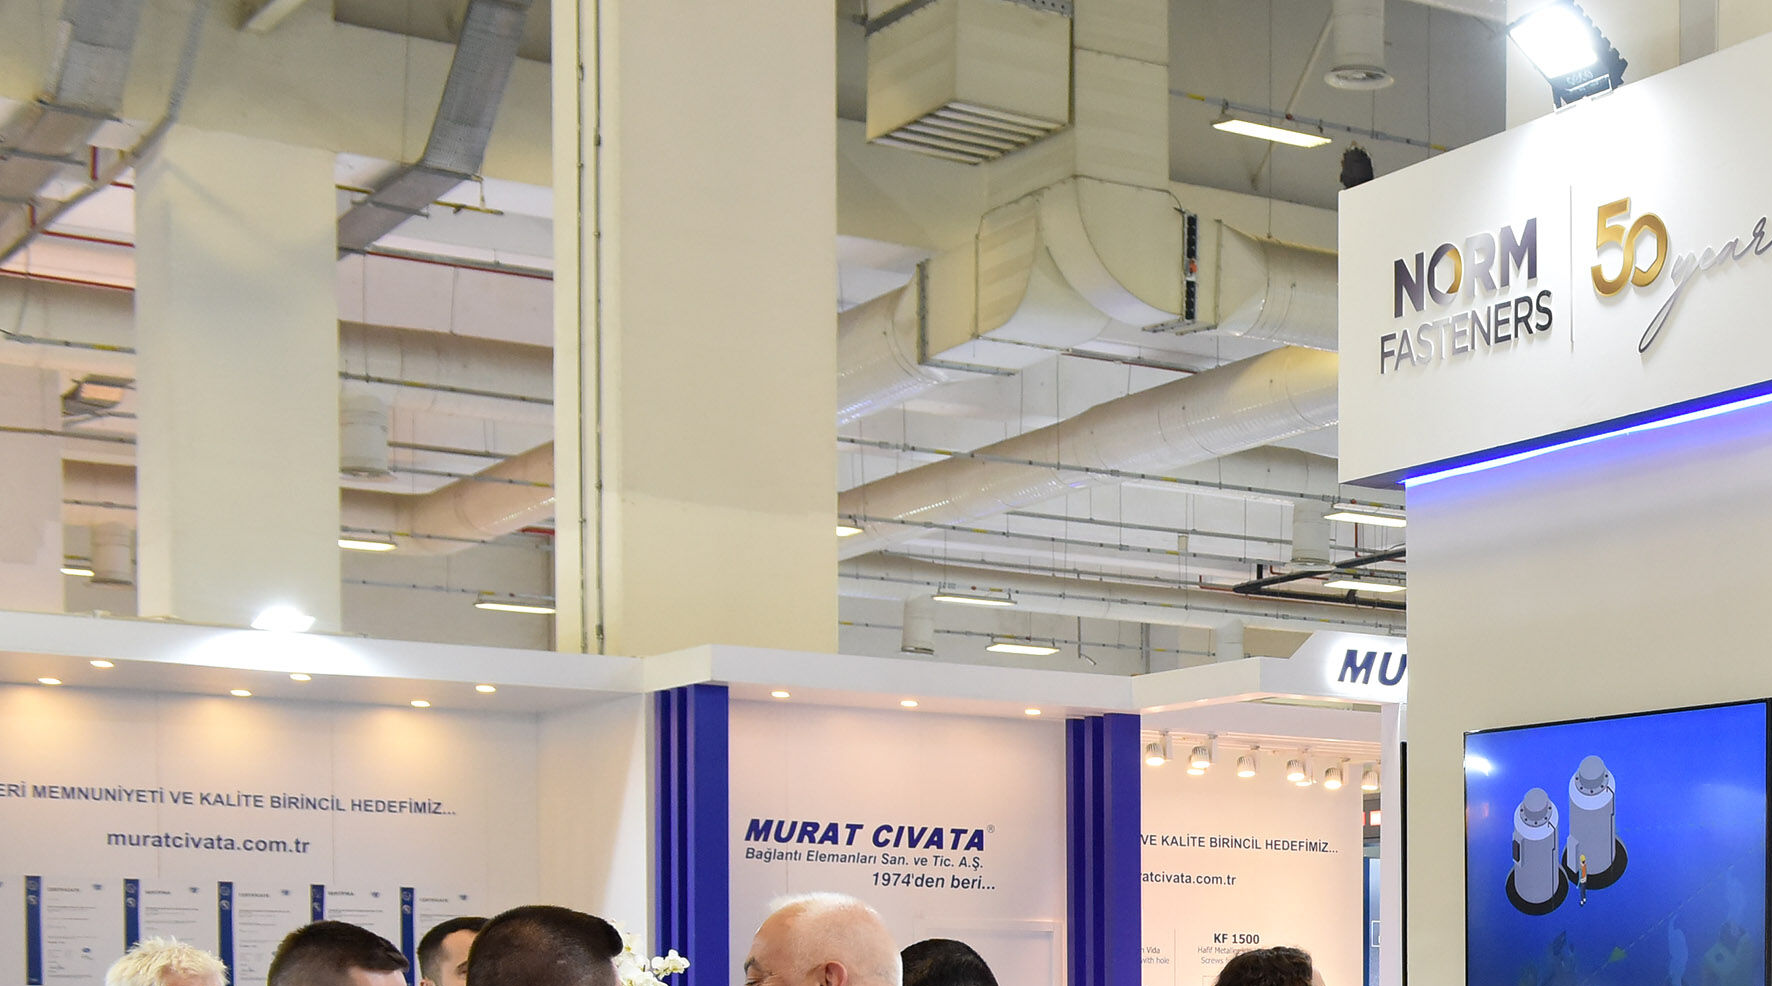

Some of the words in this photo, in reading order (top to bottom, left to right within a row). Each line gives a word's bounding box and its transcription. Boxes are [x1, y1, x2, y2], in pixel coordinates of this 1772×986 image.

[1591, 197, 1667, 297] 50
[1394, 217, 1537, 318] NORM
[1380, 289, 1553, 374] FASTENERS
[32, 785, 165, 803] MEMNUNİYETİ
[169, 791, 193, 805] VE
[200, 791, 264, 808] KALİTE
[270, 793, 346, 811] BİRİNCİL
[351, 798, 456, 815] HEDEFİMİZ...
[107, 832, 310, 853] muratcivata.com.tr
[744, 819, 864, 846] MURAT
[872, 824, 984, 851] CIVATA
[1140, 834, 1157, 845] VE
[1161, 833, 1205, 847] KALİTE
[1210, 835, 1261, 850] BİRİNCİL
[1265, 838, 1338, 853] HEDEFİMİZ...
[745, 847, 802, 863] Bağlantı
[806, 850, 876, 865] Elemanları
[881, 853, 909, 866] San.
[913, 856, 928, 866] ve
[932, 855, 954, 867] Tic.
[959, 857, 984, 871] A.Ş.
[872, 872, 945, 888] 1974'den
[950, 875, 995, 890] beri...
[1140, 871, 1236, 886] atcivata.com.tr
[1213, 933, 1228, 943] KF
[1232, 934, 1260, 944] 1500
